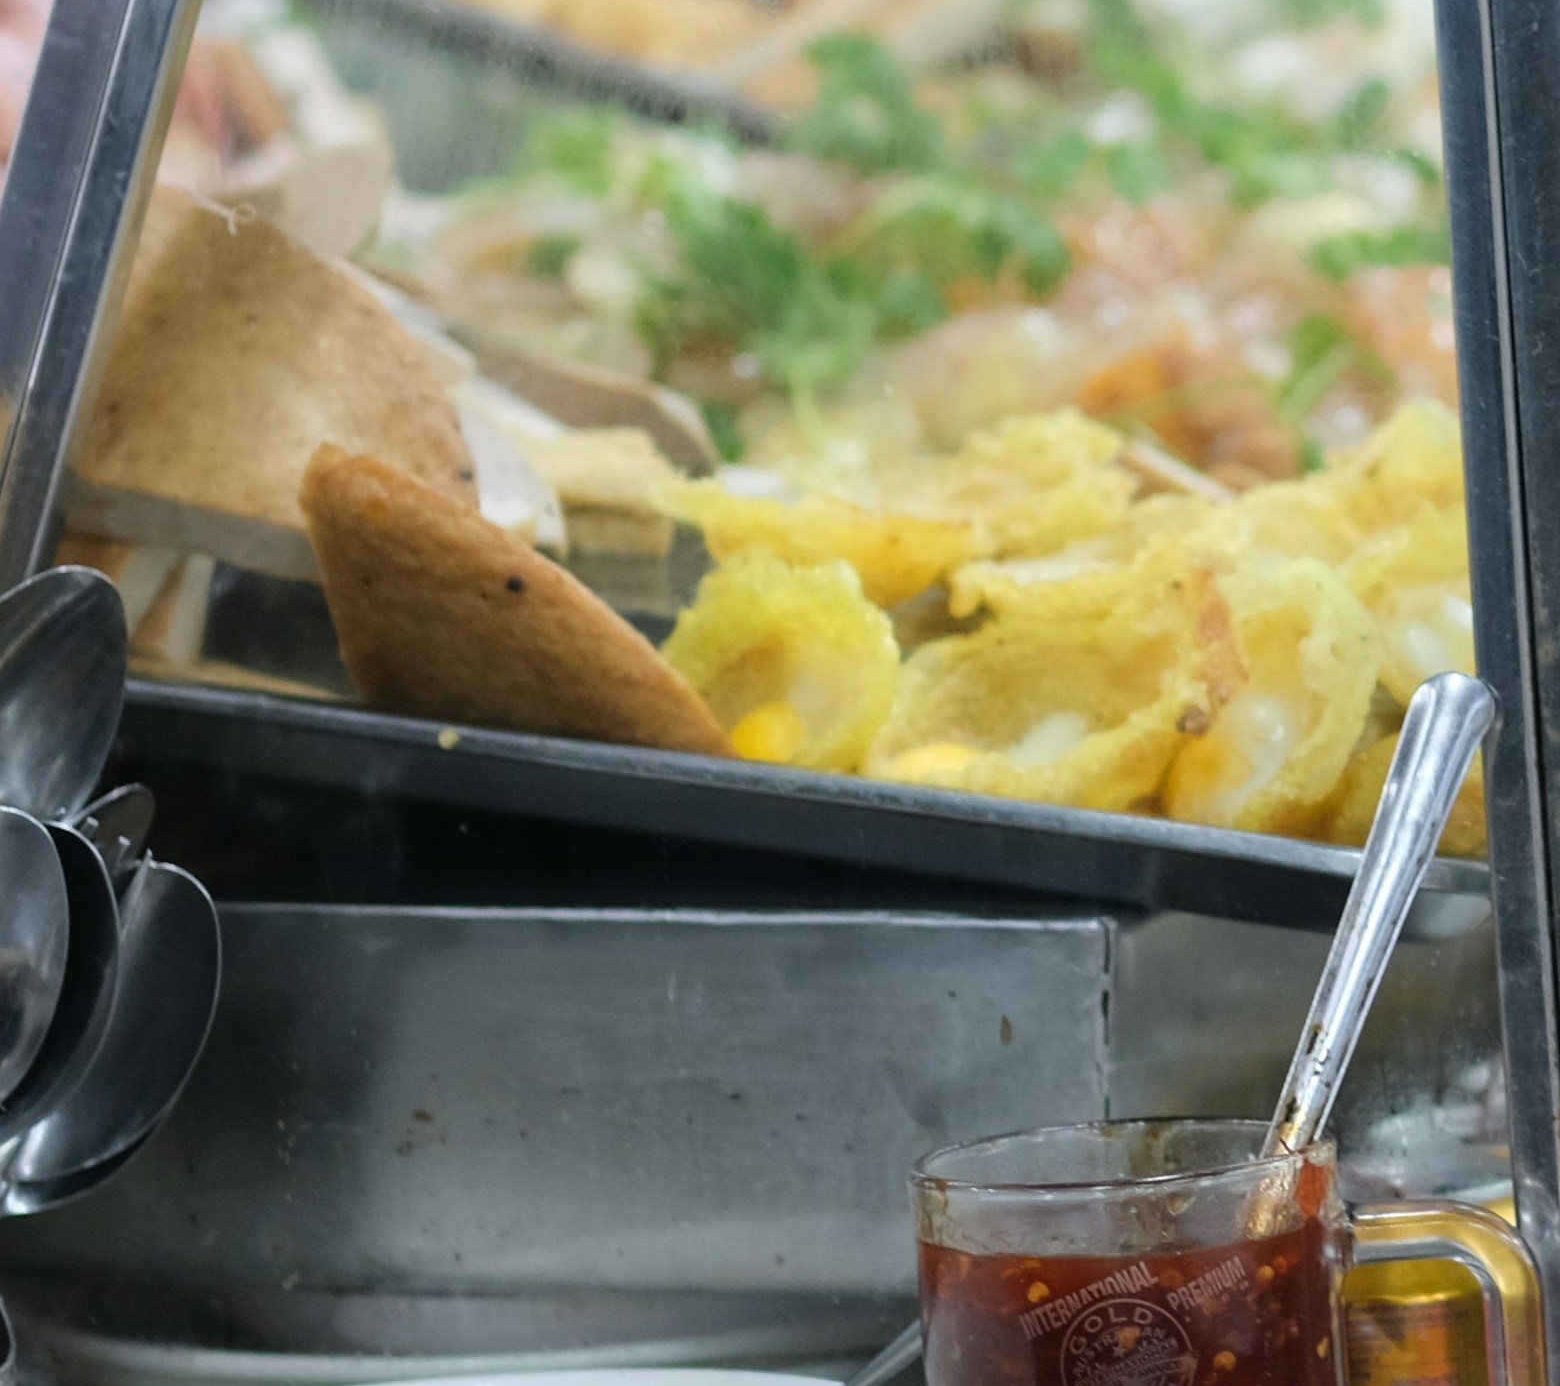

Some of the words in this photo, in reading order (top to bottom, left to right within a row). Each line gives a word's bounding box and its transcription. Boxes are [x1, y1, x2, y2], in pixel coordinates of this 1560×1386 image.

[1019, 1260, 1159, 1340] INTERNATIONAL
[1166, 1256, 1246, 1310] PREMIUM
[1069, 1306, 1153, 1354] GOLD
